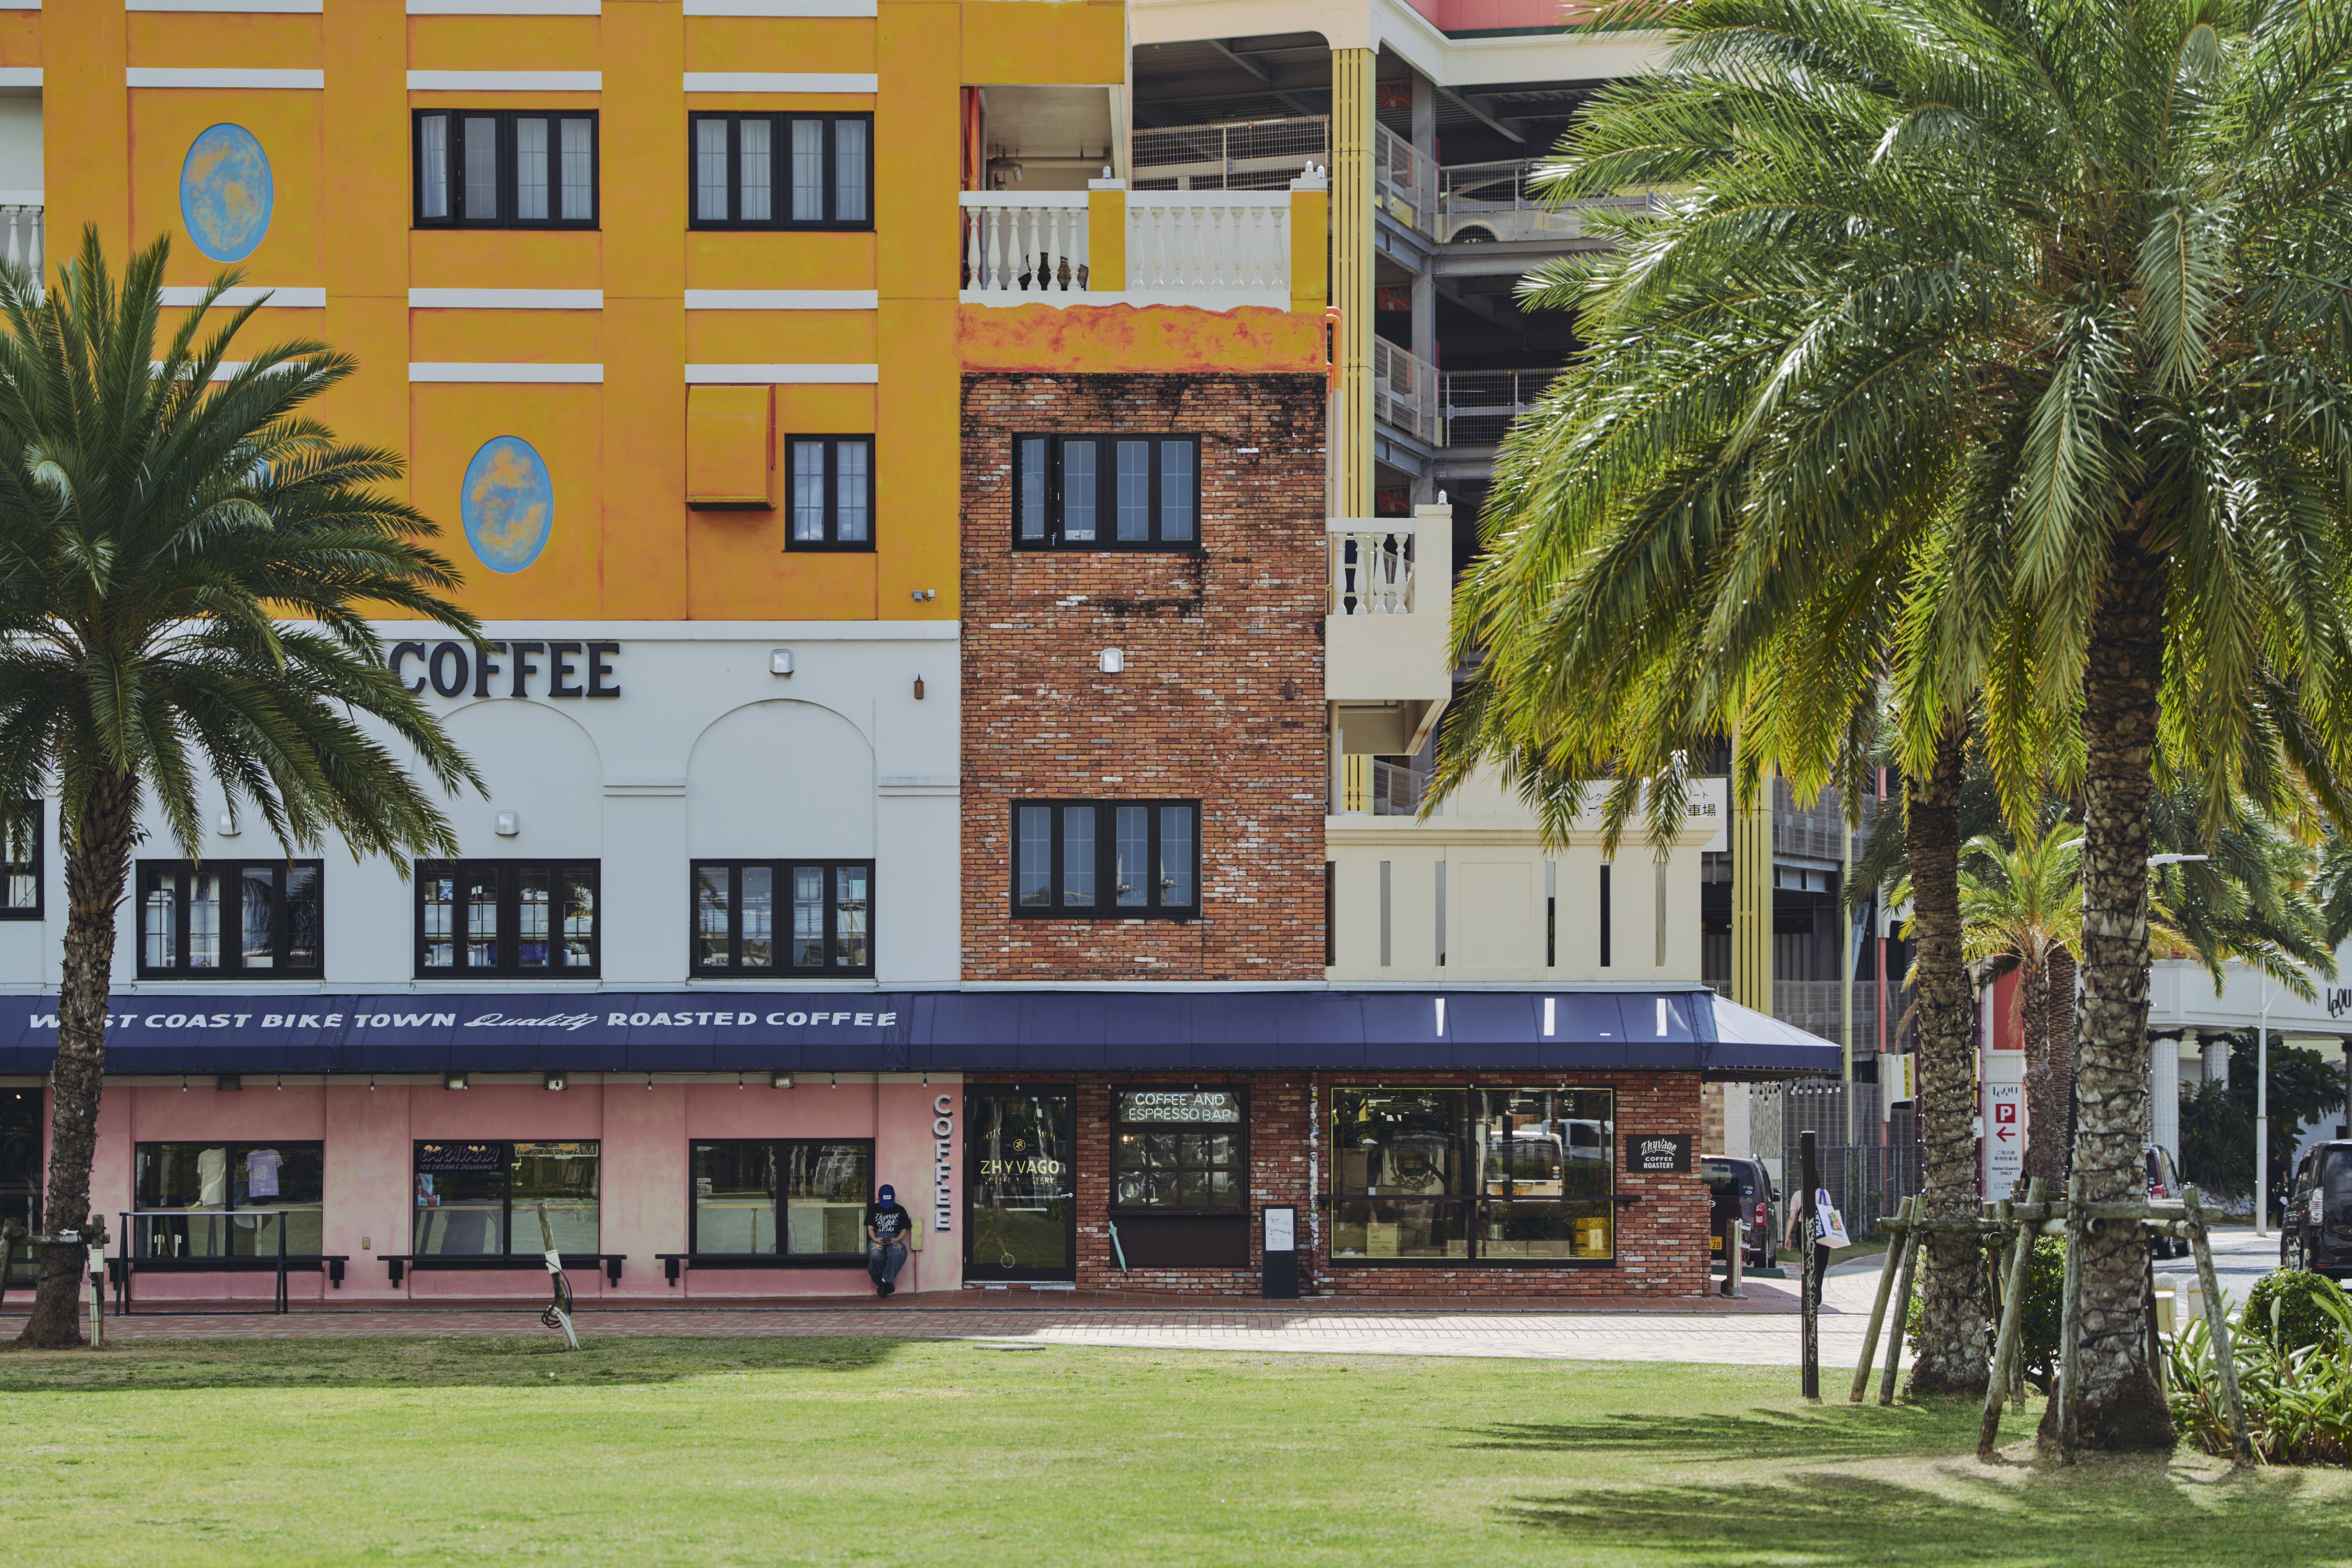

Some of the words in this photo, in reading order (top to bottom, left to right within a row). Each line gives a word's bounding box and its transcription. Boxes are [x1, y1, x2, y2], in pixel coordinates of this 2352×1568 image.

[389, 642, 620, 697] COFFEE
[30, 1014, 137, 1028] WST
[145, 1014, 252, 1028] COAST
[261, 1014, 343, 1028] BIKE
[354, 1013, 456, 1027] TOWN
[464, 1013, 598, 1031] Quality
[607, 1012, 757, 1026] ROASTED
[766, 1012, 896, 1026] COFFEE
[1135, 1093, 1187, 1105] COFFEE
[1193, 1093, 1225, 1106] AND
[1129, 1108, 1200, 1120] ESPRESSO
[1202, 1109, 1232, 1121] BAR
[2000, 1105, 2013, 1121] P
[418, 1144, 501, 1163] CARAVANA
[1641, 1138, 1677, 1156] Zhyvago
[933, 1093, 953, 1231] COFFEE
[981, 1160, 1059, 1174] ZHYVAGO
